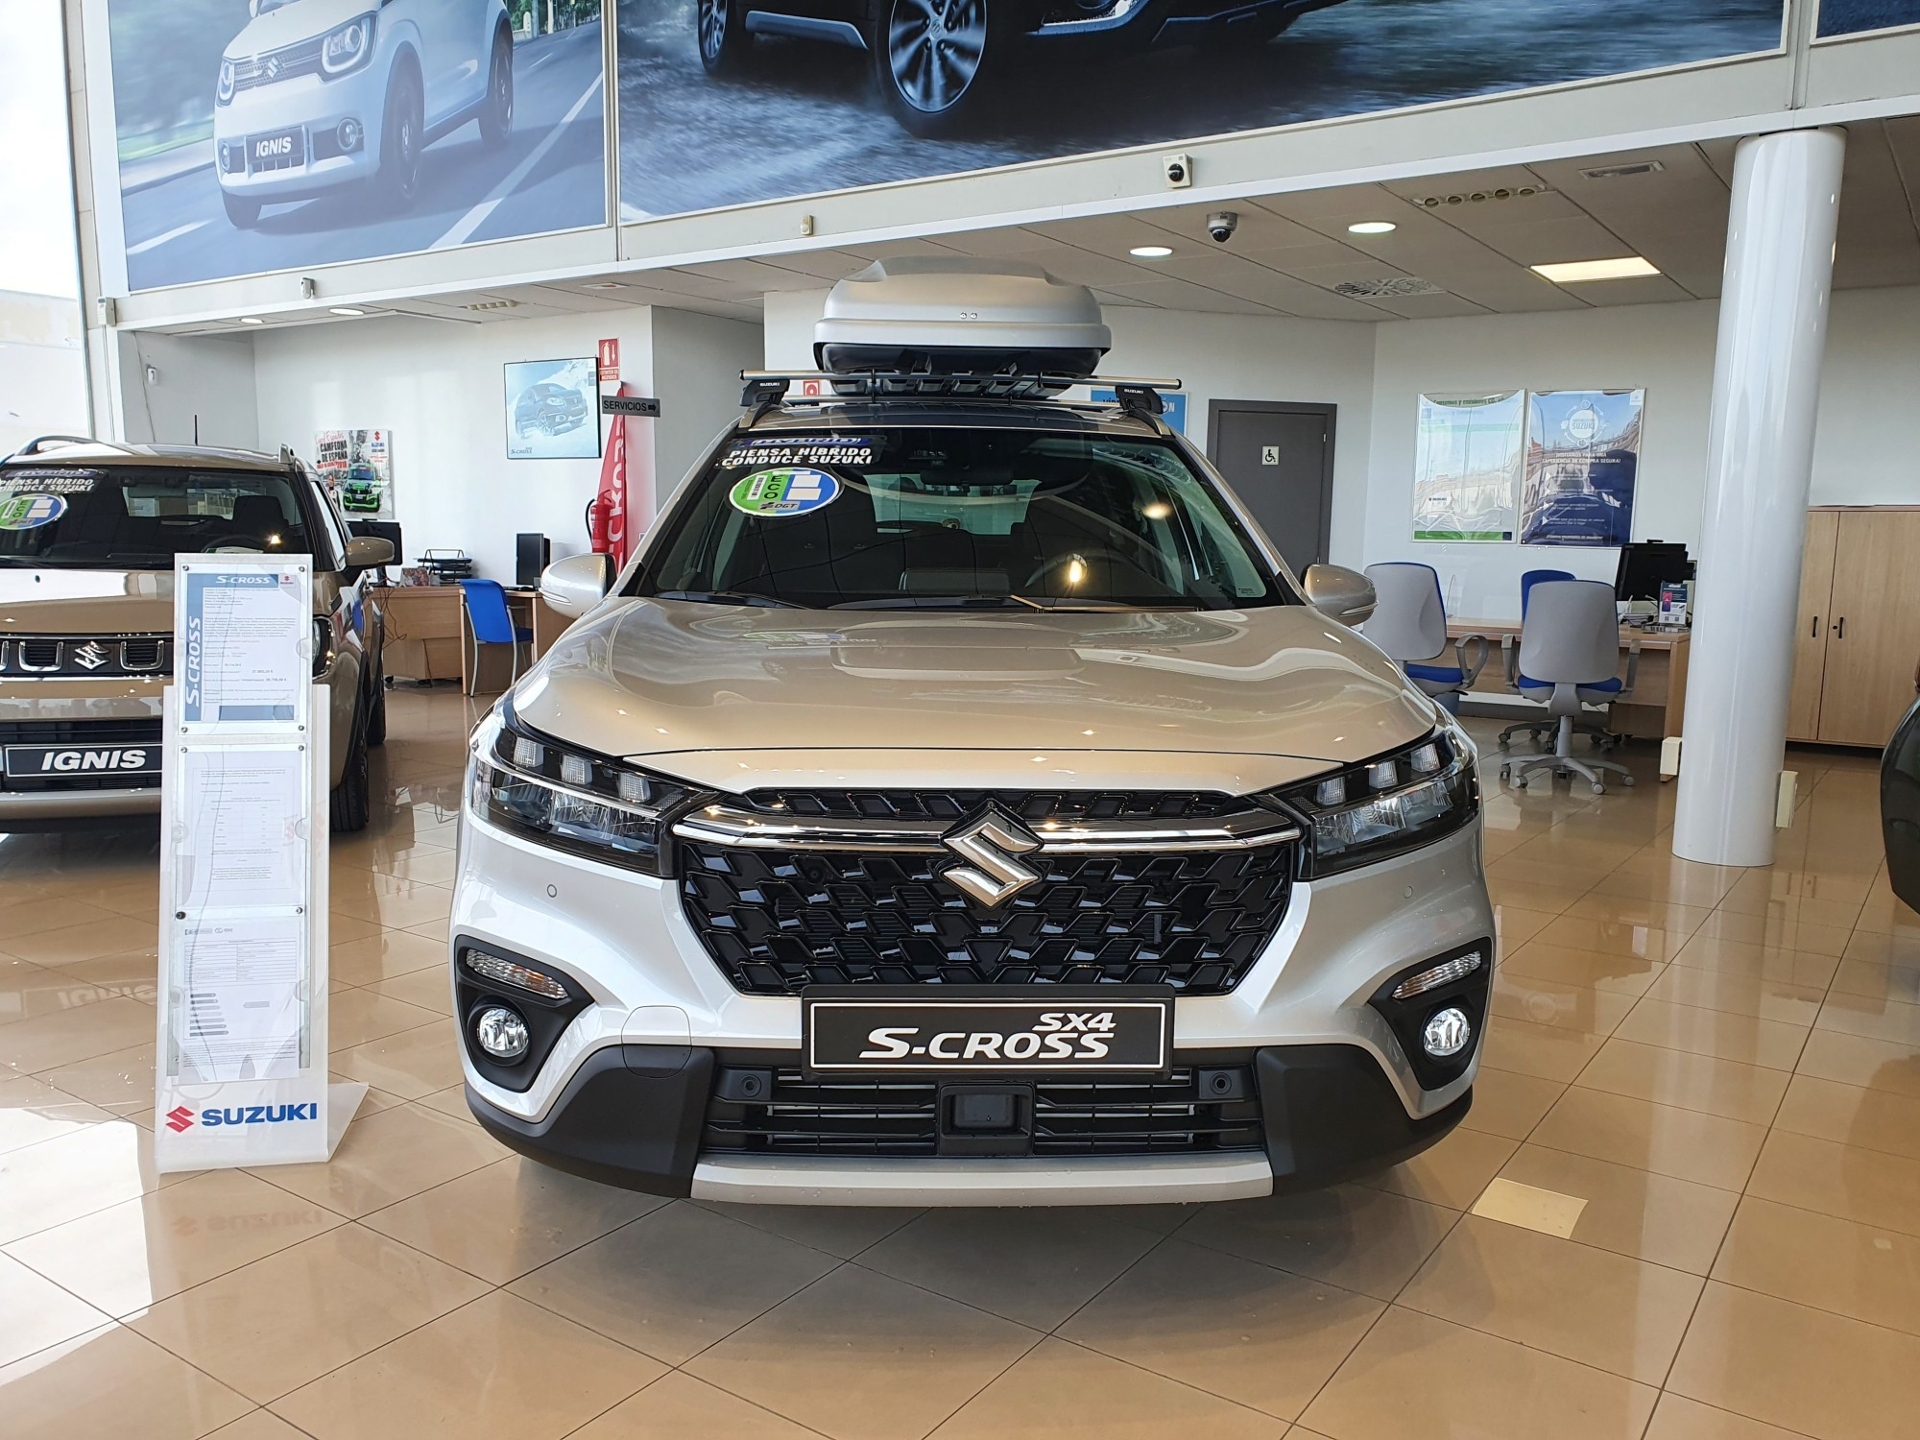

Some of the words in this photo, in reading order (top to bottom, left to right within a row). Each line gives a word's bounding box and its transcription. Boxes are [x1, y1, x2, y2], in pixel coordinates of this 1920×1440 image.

[255, 136, 292, 157] IGNIS
[603, 400, 647, 412] SERVICIOS
[721, 455, 802, 467] CONDUCE
[808, 455, 873, 465] SUZUKI
[729, 447, 791, 458] PIENSA
[797, 446, 872, 456] HÍBRIDO
[764, 475, 782, 499] ECO
[215, 575, 271, 584] S-CROSS
[185, 616, 201, 708] S-CROSS
[41, 750, 147, 771] IGNIS
[1032, 1012, 1117, 1031] SX4
[858, 1027, 1115, 1059] S-CROSS
[201, 1103, 318, 1127] SUZUKI
